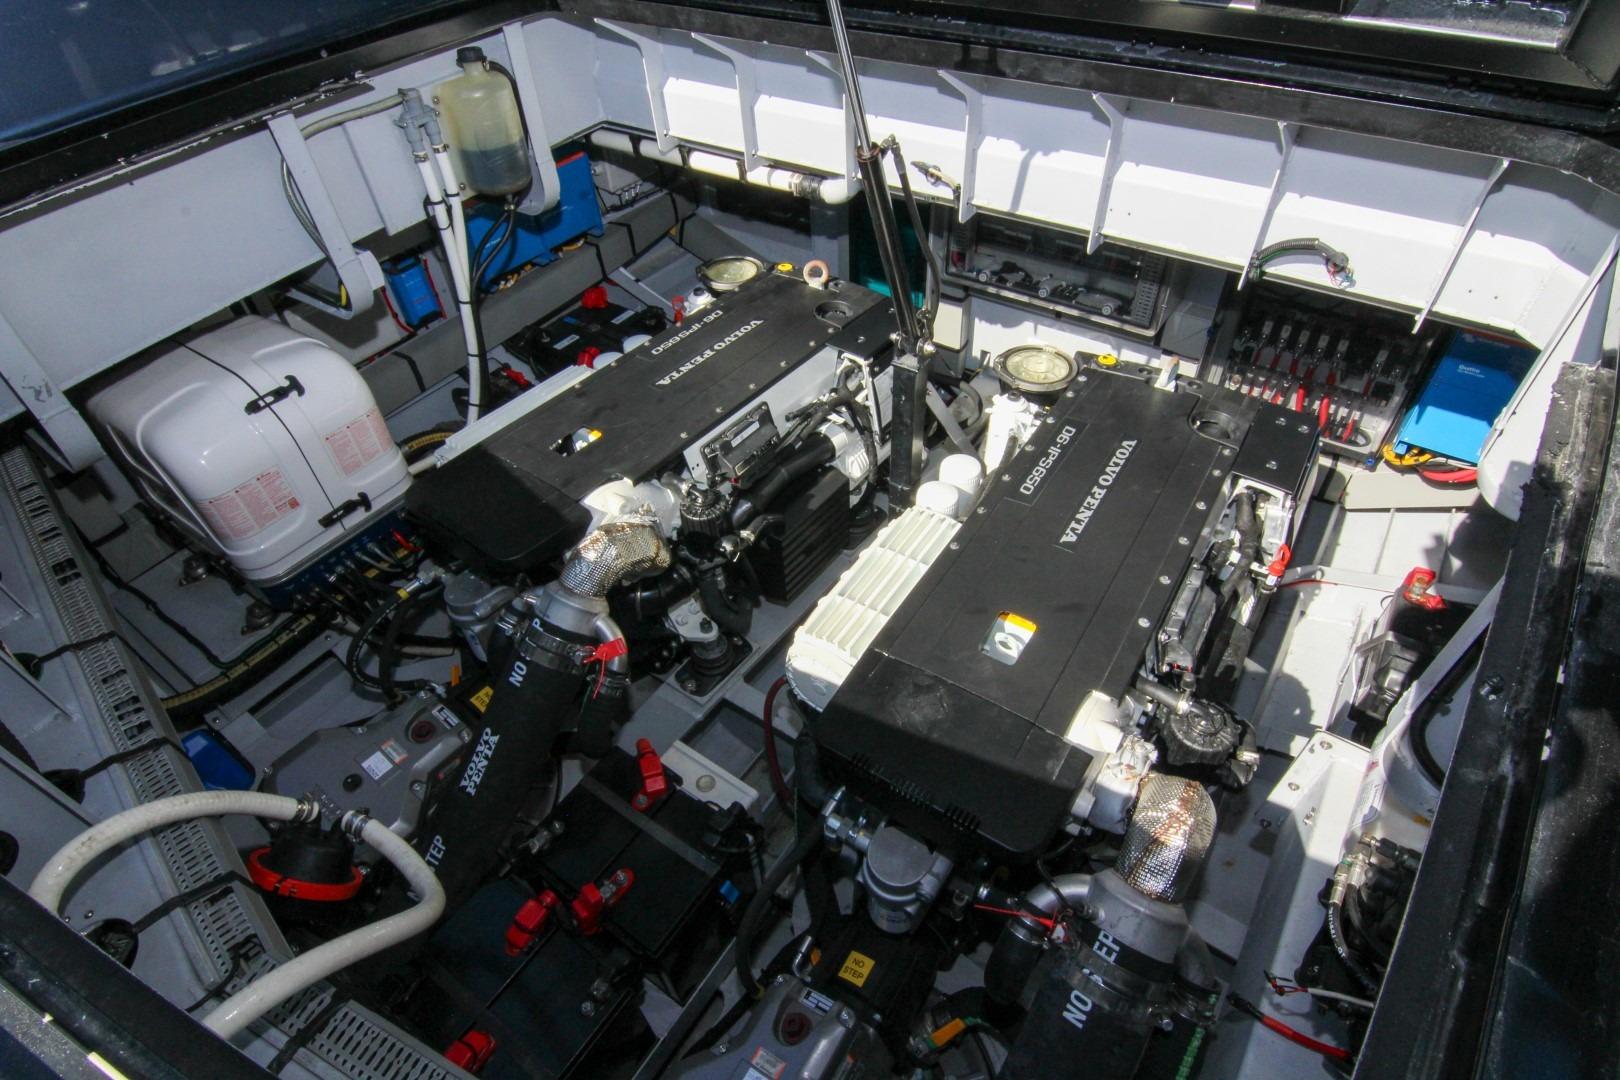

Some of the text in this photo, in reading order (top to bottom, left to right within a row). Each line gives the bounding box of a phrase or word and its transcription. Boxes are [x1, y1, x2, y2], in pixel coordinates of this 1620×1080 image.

[656, 319, 764, 385] VOLVO PENTA
[1019, 425, 1077, 495] D6-IPS650
[1059, 439, 1137, 543] VOLVO PENTA
[508, 661, 528, 688] NO
[459, 727, 492, 788] VOLVO
[466, 733, 500, 797] PENTA
[425, 835, 447, 872] TEP
[842, 965, 865, 980] STEP
[851, 957, 865, 969] NO
[1062, 989, 1093, 1029] NO
